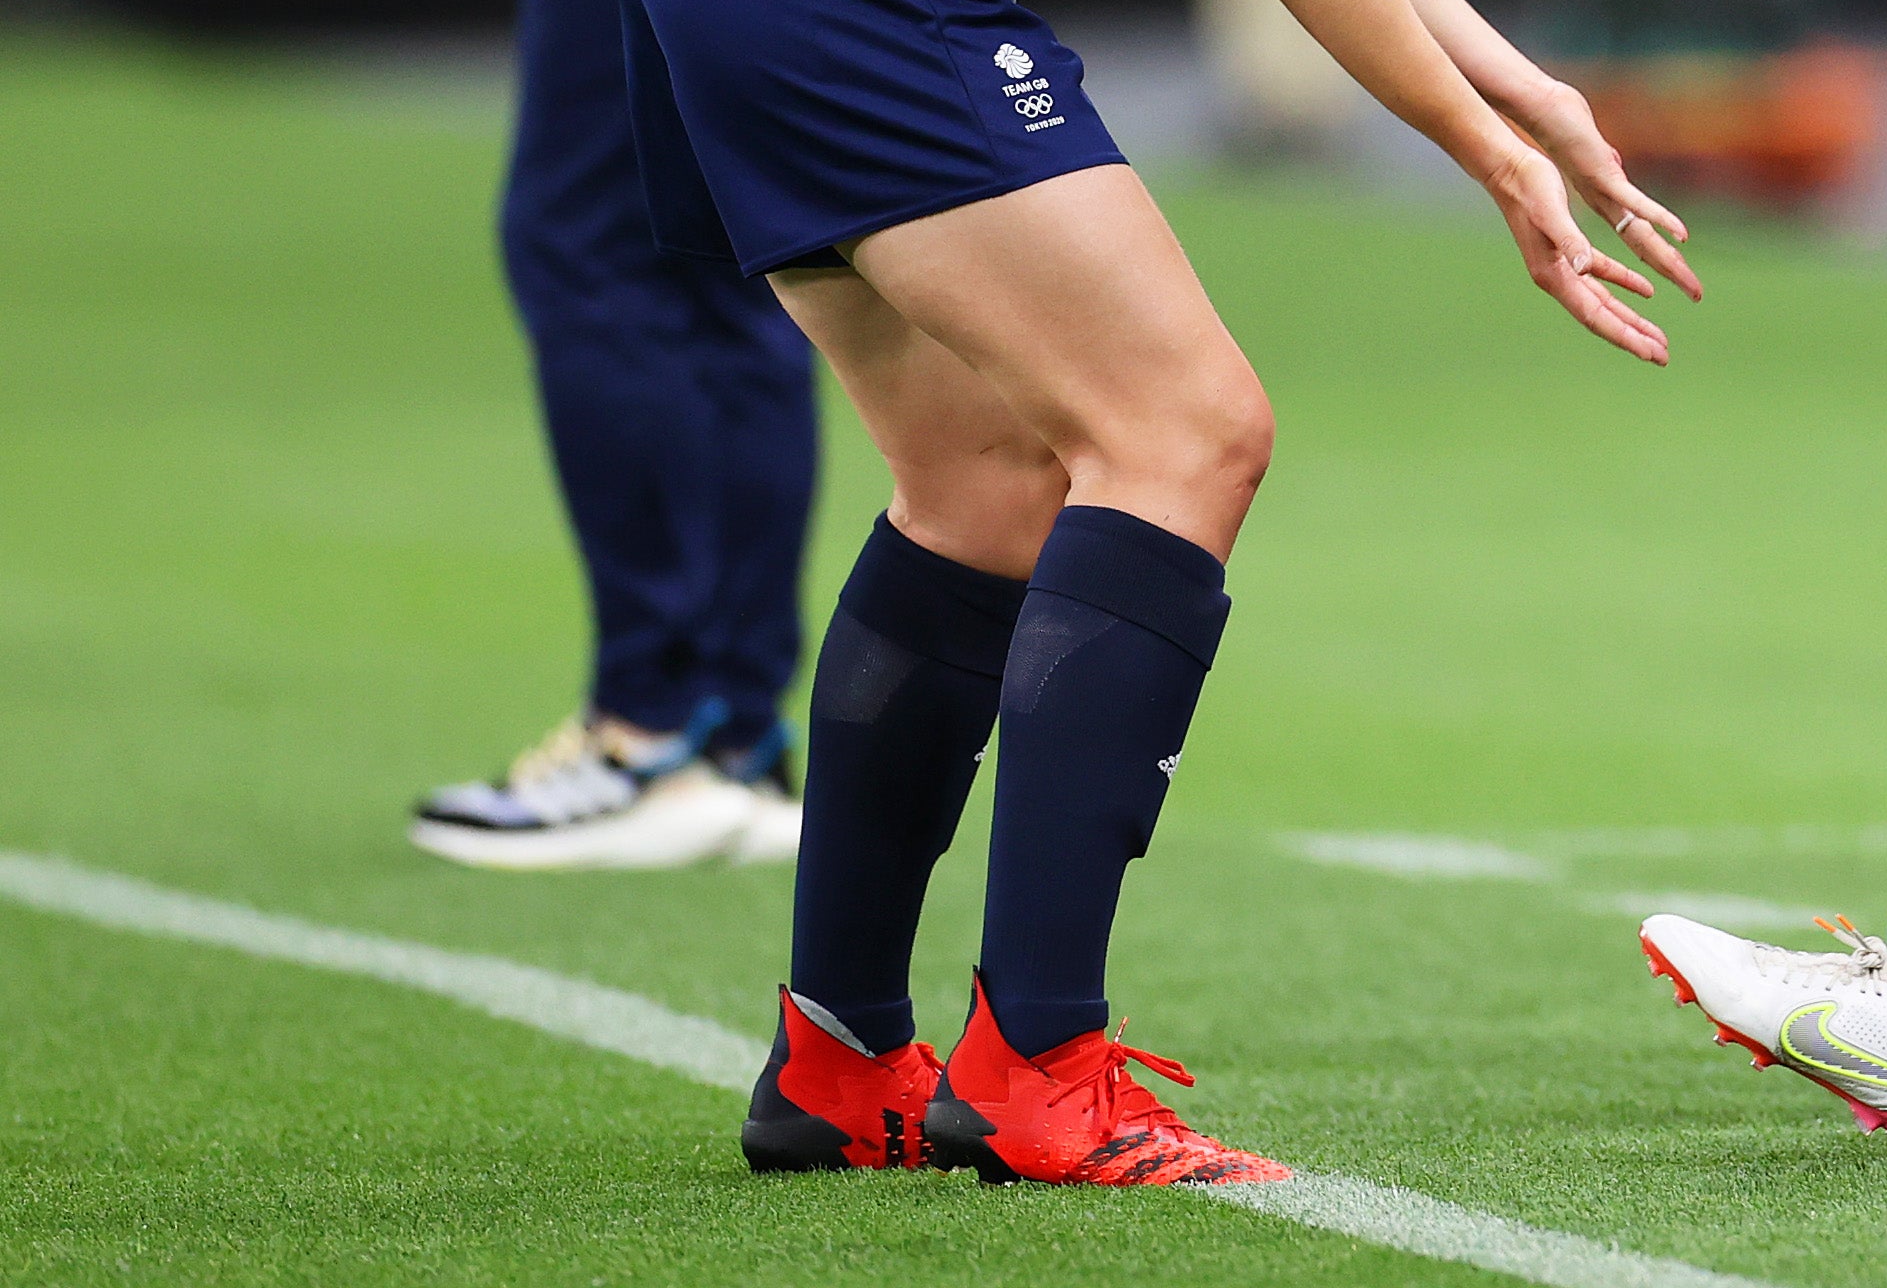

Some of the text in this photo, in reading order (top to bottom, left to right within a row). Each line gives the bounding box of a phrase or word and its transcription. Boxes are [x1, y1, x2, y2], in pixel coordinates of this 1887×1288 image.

[1002, 78, 1049, 97] TEAM GB
[1025, 120, 1048, 132] TOKYO
